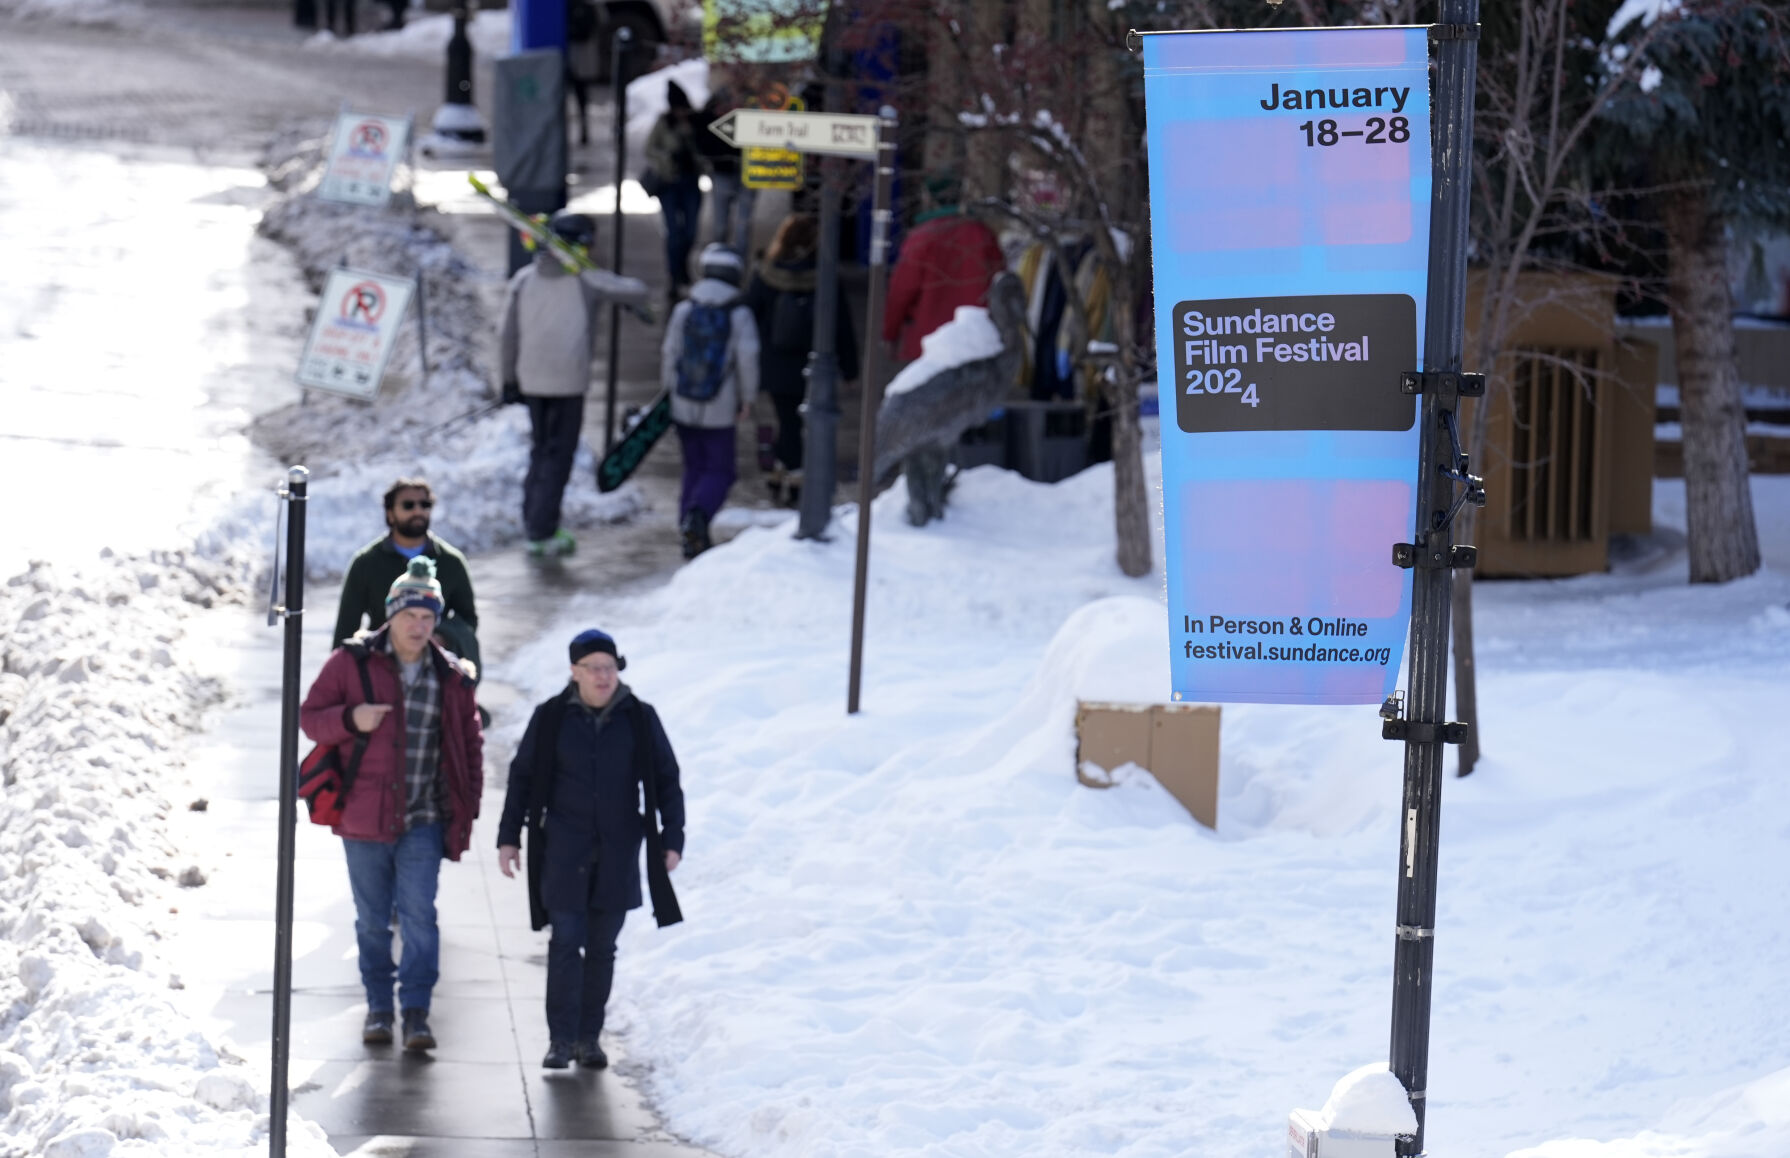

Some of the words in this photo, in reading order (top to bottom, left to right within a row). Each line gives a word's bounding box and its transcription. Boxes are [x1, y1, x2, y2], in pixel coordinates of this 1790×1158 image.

[1260, 83, 1411, 113] January
[1183, 308, 1336, 336] Sundance
[1184, 339, 1248, 366] Film
[1256, 335, 1370, 363] Festival
[1185, 368, 1260, 408] 2024
[1184, 615, 1204, 634] In
[1209, 615, 1285, 635] Person
[1289, 616, 1303, 635] &
[1307, 617, 1368, 637] Online
[1184, 641, 1391, 665] festival.sundance.org
